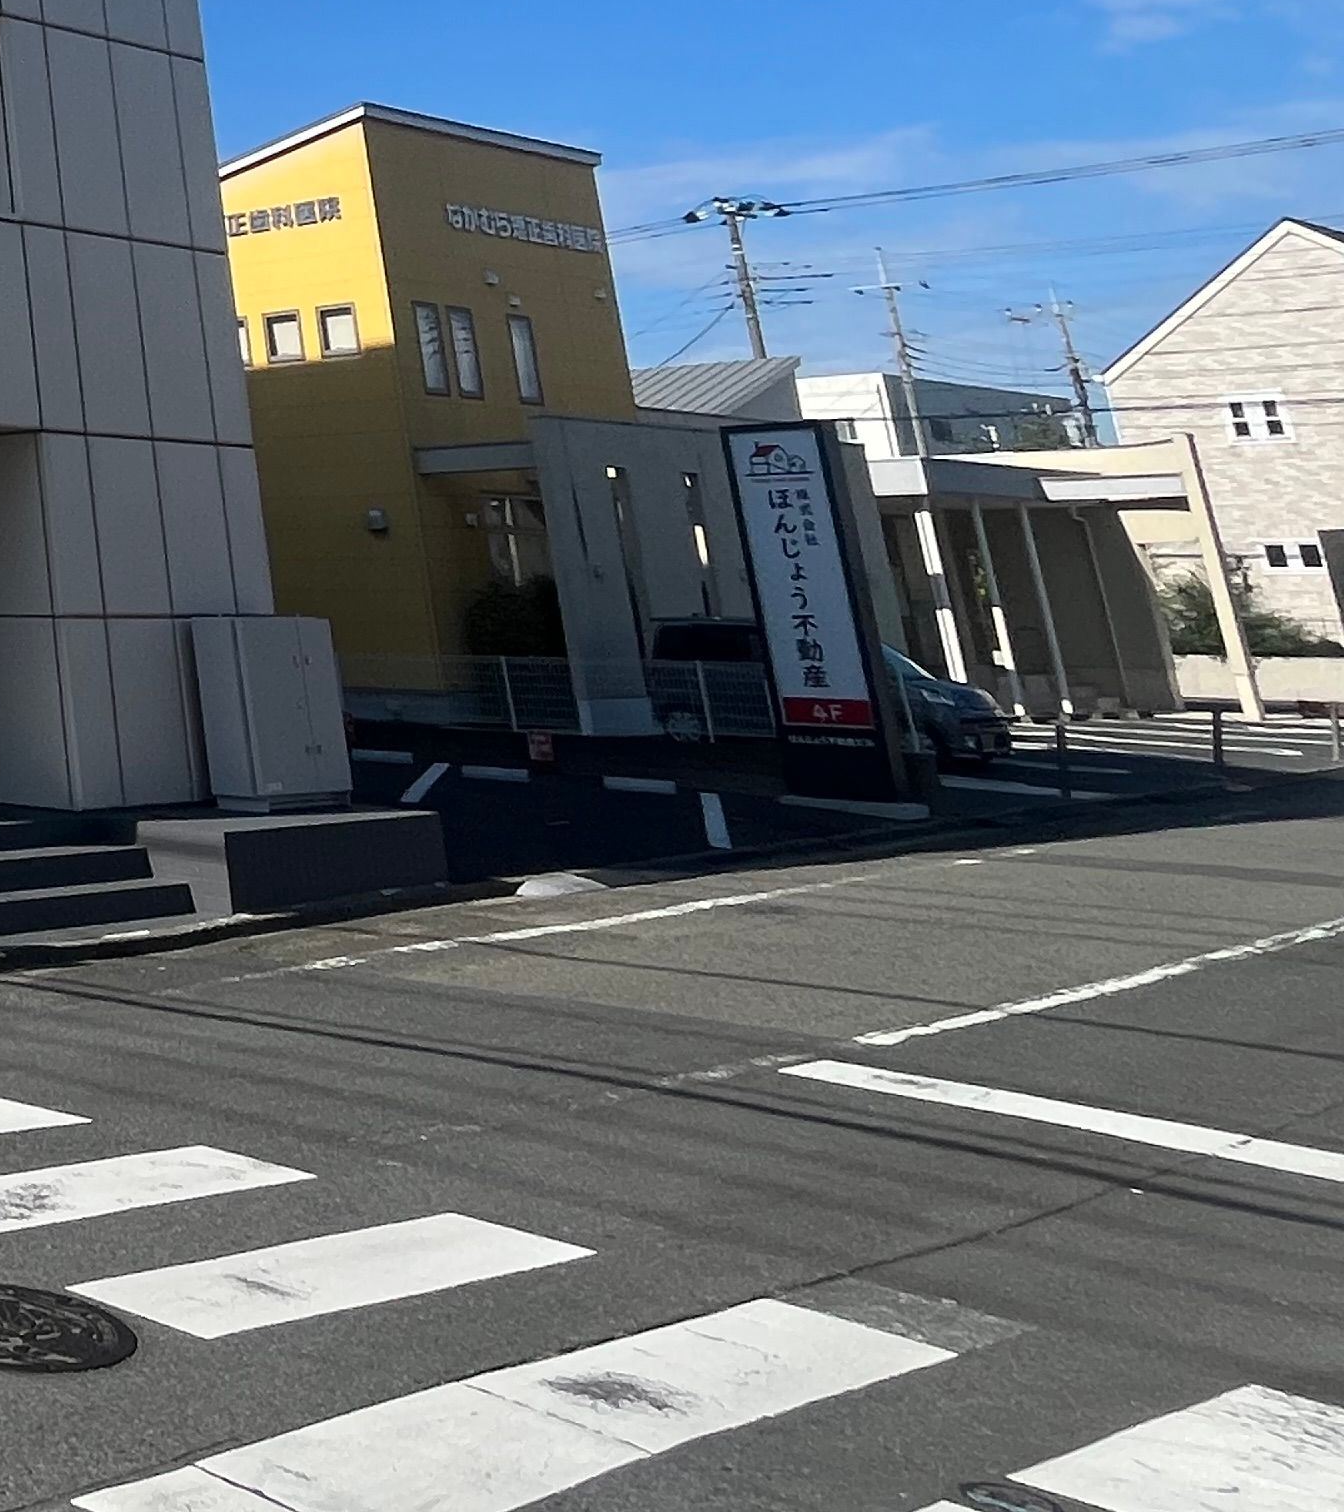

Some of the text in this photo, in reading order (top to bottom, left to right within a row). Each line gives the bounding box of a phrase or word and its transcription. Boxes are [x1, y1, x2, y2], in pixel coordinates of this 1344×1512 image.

[768, 488, 831, 687] ほんじょう不動産
[813, 704, 843, 722] 4F
